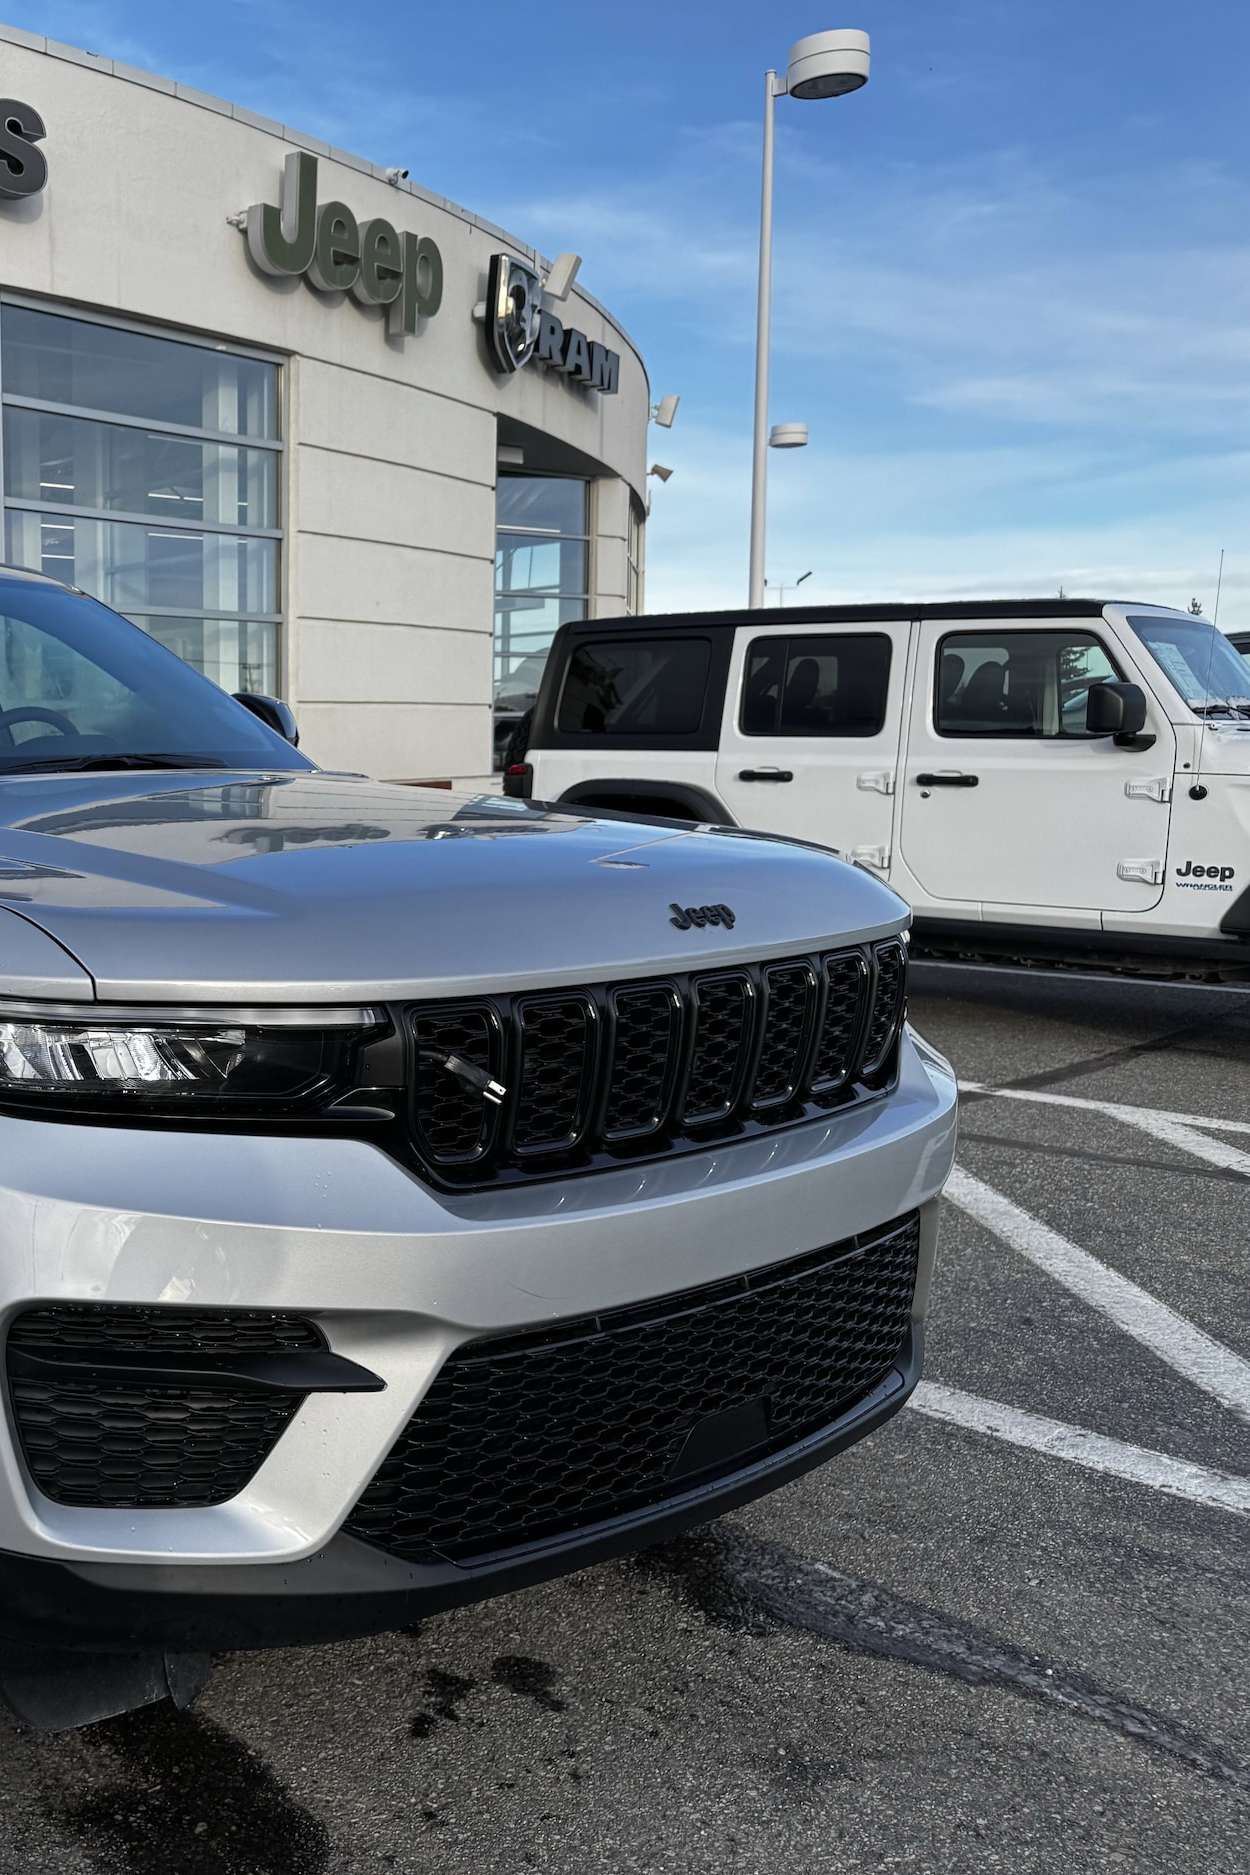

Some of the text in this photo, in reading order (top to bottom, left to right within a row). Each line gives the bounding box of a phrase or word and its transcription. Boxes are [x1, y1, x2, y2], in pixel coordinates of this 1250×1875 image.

[247, 151, 443, 336] Jeep
[534, 308, 620, 394] RAM
[1175, 860, 1235, 882] Jeep
[669, 903, 736, 930] Jeep
